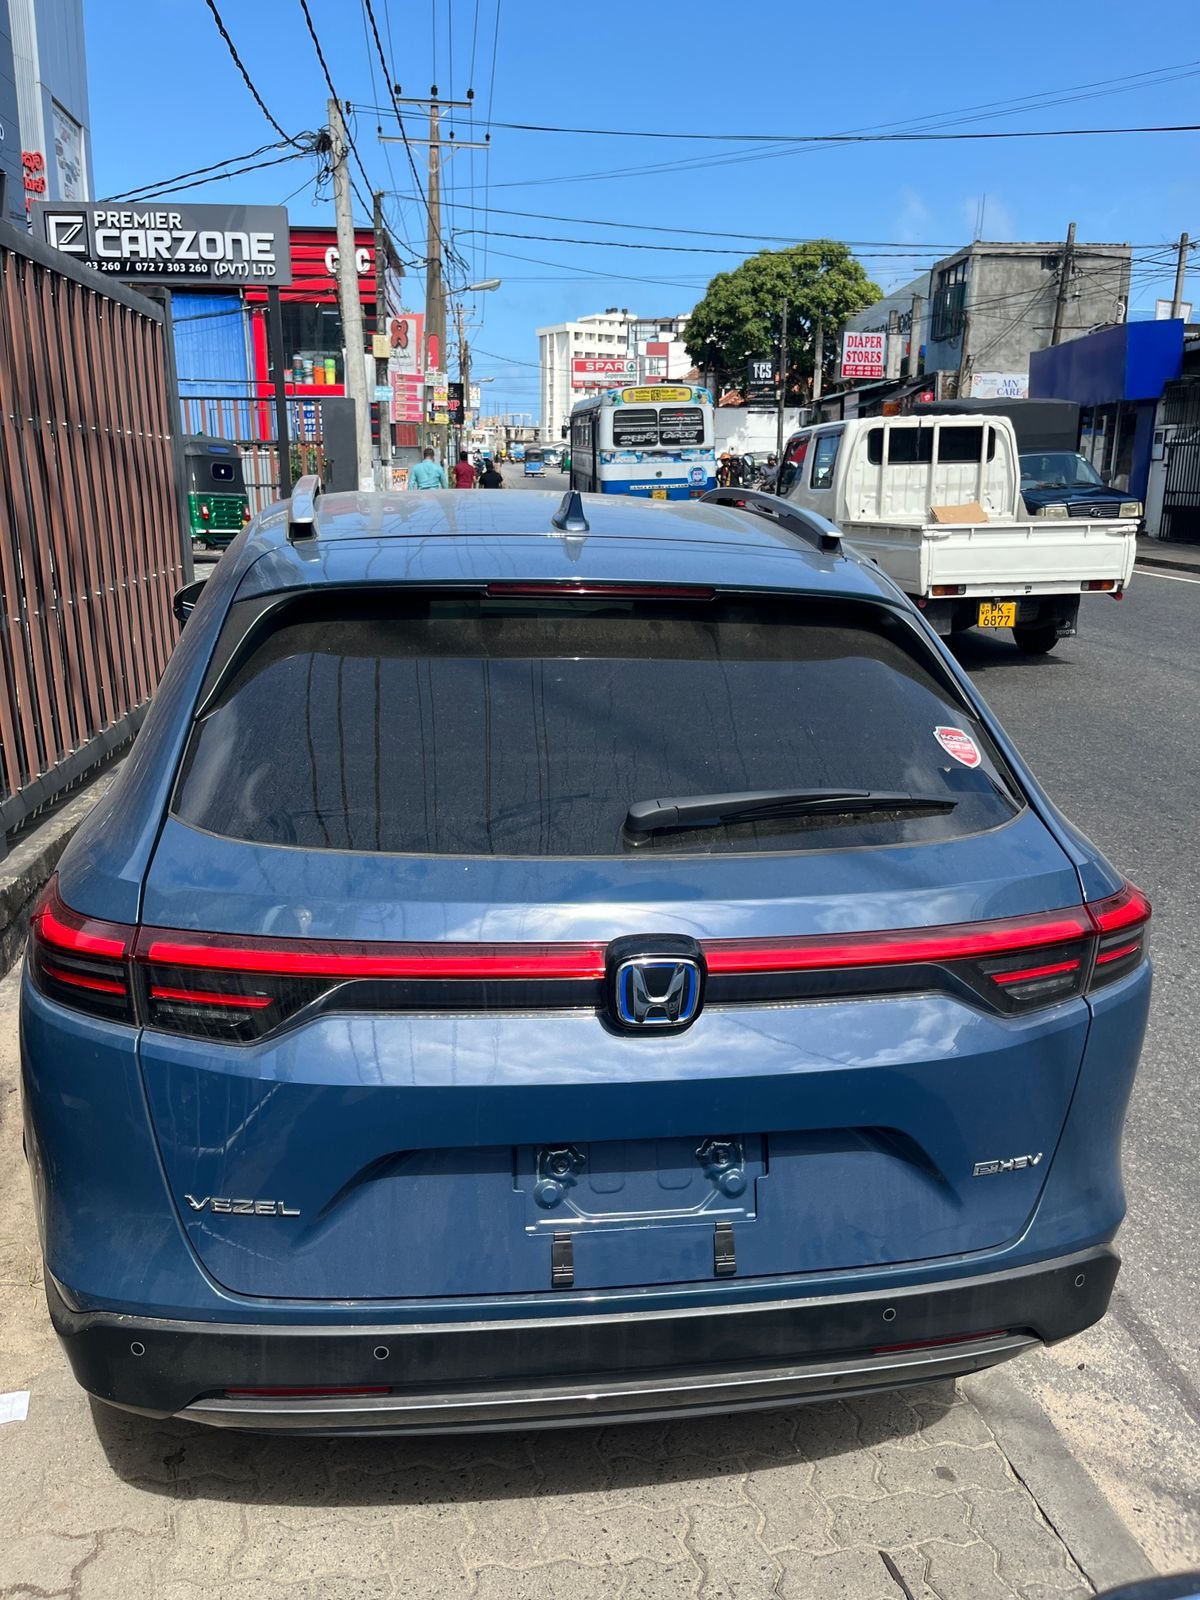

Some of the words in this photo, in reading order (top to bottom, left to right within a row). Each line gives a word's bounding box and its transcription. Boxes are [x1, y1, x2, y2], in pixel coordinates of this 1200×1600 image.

[93, 210, 183, 229] PREMIER
[95, 229, 276, 261] CARZONE
[101, 261, 121, 271] 260
[135, 261, 155, 271] 072
[158, 262, 164, 271] 7
[167, 263, 186, 272] 303
[189, 263, 208, 273] 260
[325, 247, 370, 274] CC
[214, 261, 249, 277] (PVT)
[253, 262, 276, 276] LTD
[847, 335, 882, 348] DIAPER
[846, 350, 882, 363] STORES
[585, 362, 624, 371] SPAR
[753, 362, 772, 379] TCS
[1003, 379, 1019, 388] MN
[996, 387, 1022, 396] CARE
[990, 603, 1005, 615] PK
[983, 615, 1011, 626] 6877
[184, 1194, 300, 1215] VEZEL
